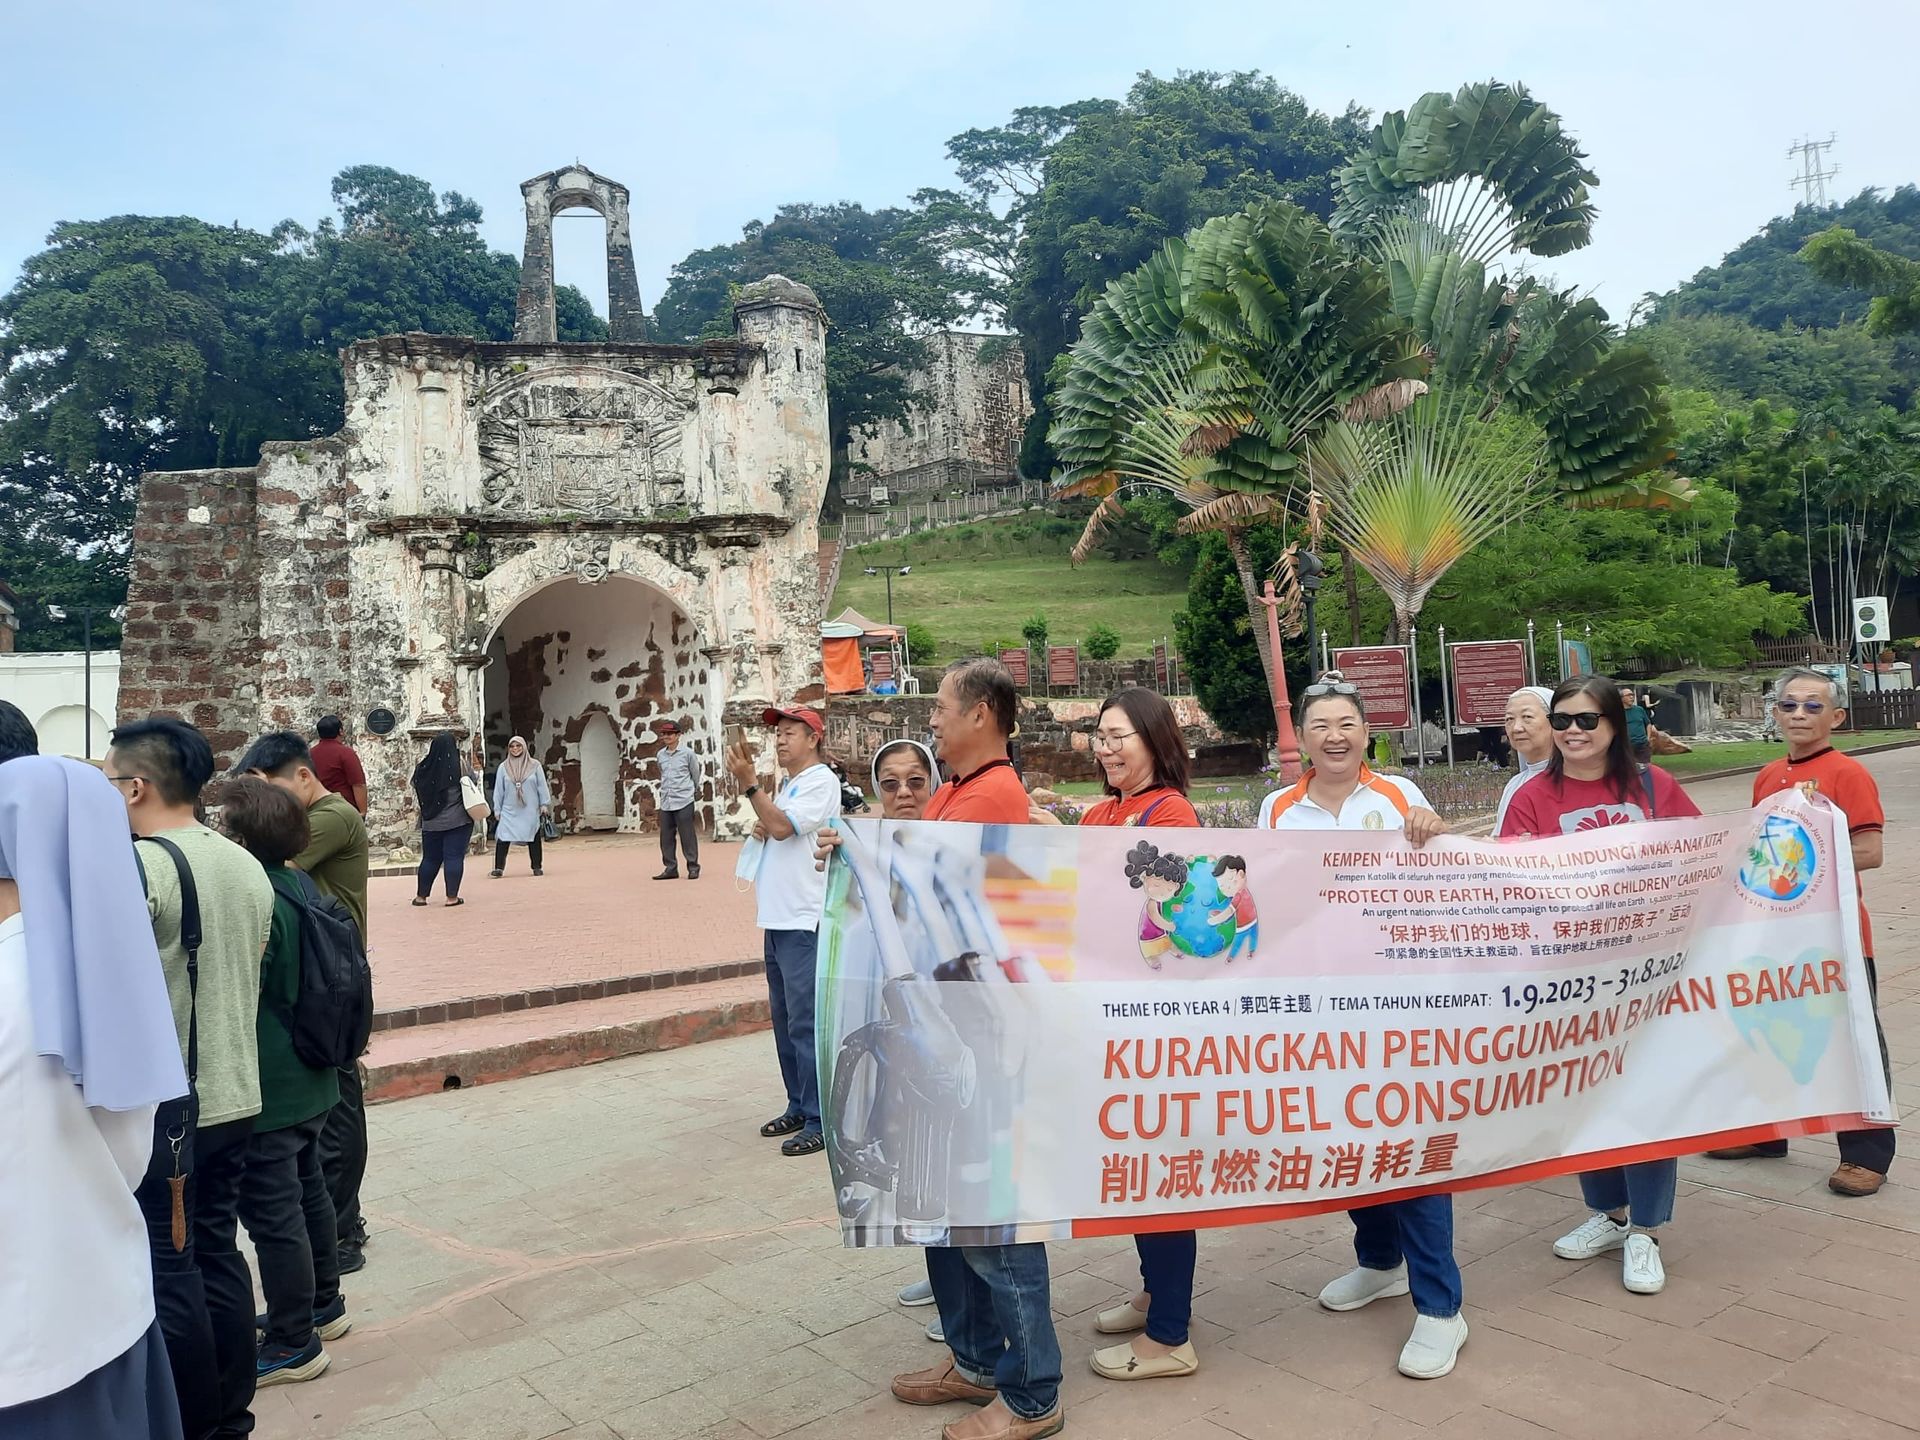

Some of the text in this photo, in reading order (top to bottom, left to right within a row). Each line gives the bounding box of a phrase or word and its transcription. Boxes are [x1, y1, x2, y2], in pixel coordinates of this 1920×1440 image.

[1323, 852, 1381, 867] KEMPEN
[1385, 851, 1470, 867] “LINDUNGI
[1474, 852, 1512, 868] BUMI
[1515, 854, 1555, 871] KITA,
[1557, 846, 1636, 868] LINDUNGI
[1811, 827, 1826, 854] Justice
[1319, 865, 1724, 904] “PROTECT OUR EARTH, PROTECT OUR CHILDREN” CAMPAIGN
[1335, 873, 1365, 882] Kempen
[1367, 872, 1396, 881] Katolik
[1398, 872, 1406, 881] di
[1407, 872, 1434, 881] seluruh
[1436, 873, 1466, 883] negara
[1467, 872, 1488, 882] yang
[1552, 869, 1598, 880] melindungi
[1362, 908, 1375, 917] An
[1376, 907, 1408, 919] urgent
[1409, 906, 1460, 917] nationwide
[1461, 905, 1500, 916] Catholic
[1501, 904, 1547, 916] campaign
[1549, 904, 1559, 913] to
[1561, 903, 1594, 914] protect
[1595, 901, 1604, 911] all
[1605, 899, 1617, 909] life
[1618, 900, 1626, 908] on
[1628, 896, 1645, 907] Earth
[1102, 1002, 1150, 1018] THEME
[1153, 1001, 1181, 1016] FOR
[1184, 1000, 1220, 1015] YEAR
[1222, 1000, 1231, 1015] 4
[1240, 994, 1313, 1015] 第四年主题
[1329, 996, 1370, 1011] TEMA
[1373, 995, 1421, 1010] TAHUN
[1425, 992, 1492, 1009] KEEMPAT:
[1501, 975, 1596, 1014] 1.9.2023
[1103, 959, 1848, 1080] KURANGKAN PENGGUNAAN BAHAN BAKAR
[1099, 1041, 1630, 1140] CUT FUEL CONSUMPTION
[1100, 1132, 1459, 1204] 削减燃油消耗量
